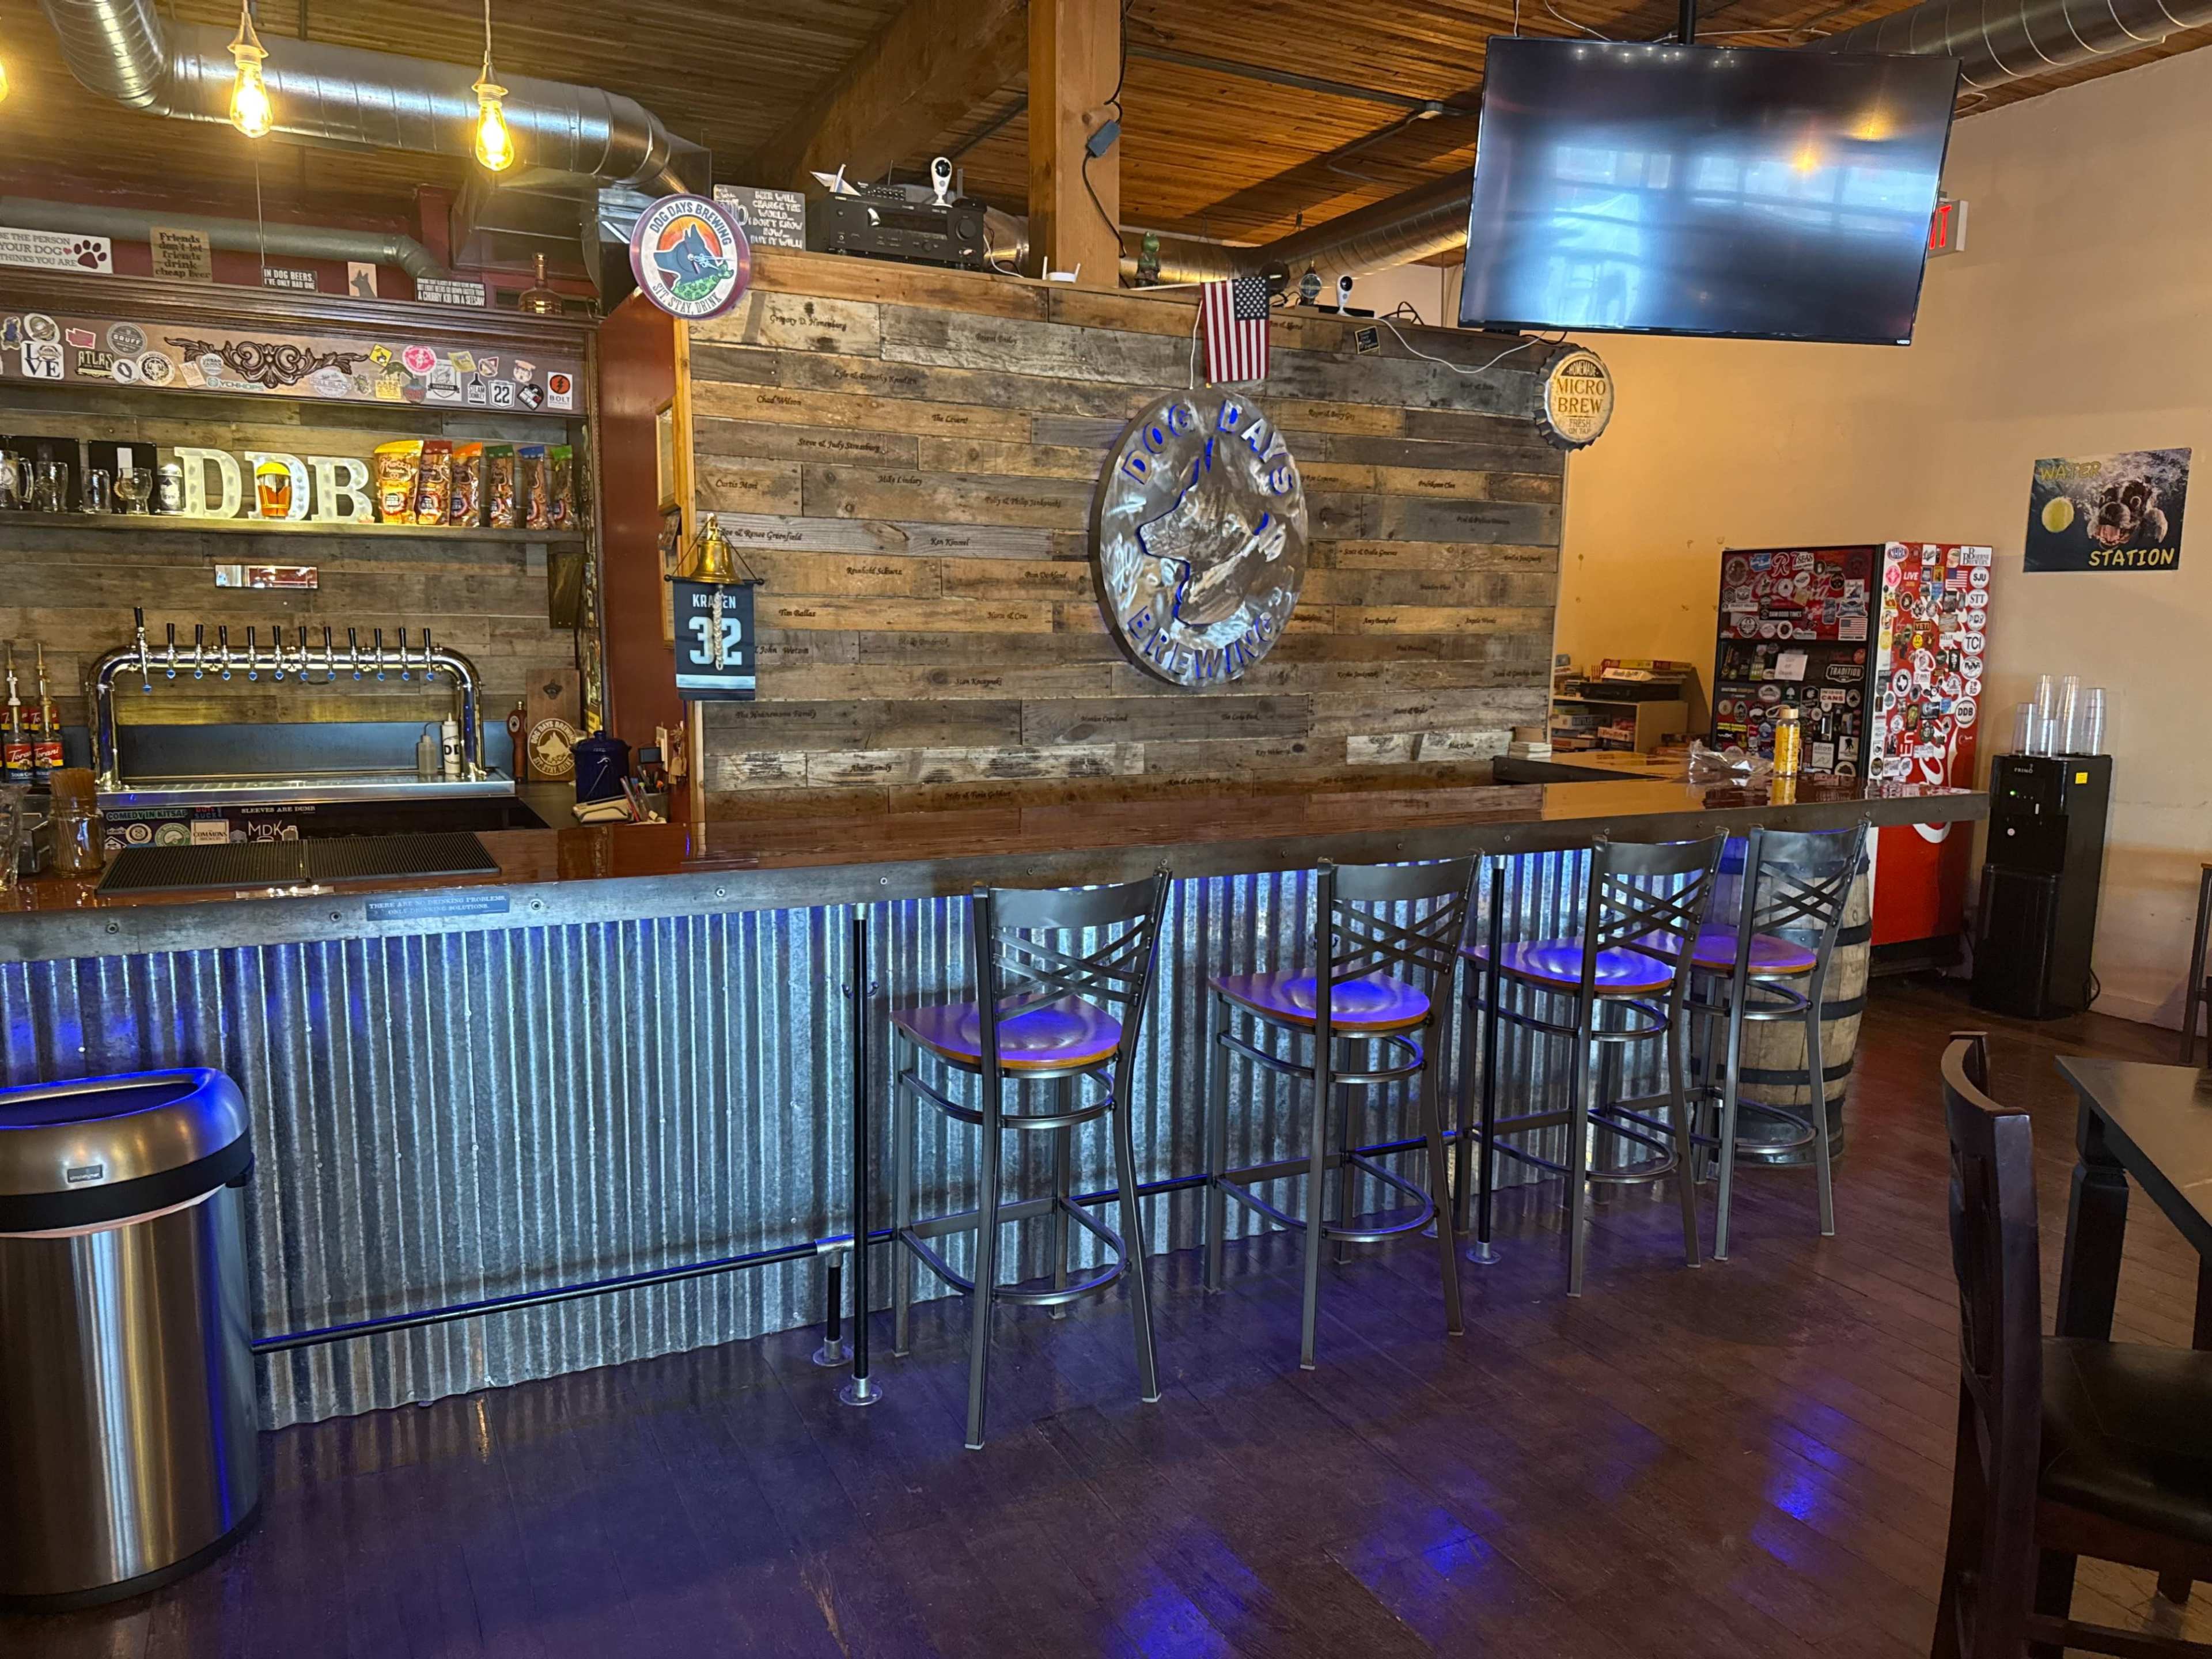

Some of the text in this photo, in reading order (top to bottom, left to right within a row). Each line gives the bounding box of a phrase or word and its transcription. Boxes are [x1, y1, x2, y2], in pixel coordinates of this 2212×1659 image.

[755, 191, 797, 203] BEER WILL
[649, 202, 732, 246] DOG DAYS BREWING
[779, 219, 803, 230] KNOW
[11, 233, 70, 245] THE PERSON
[159, 232, 200, 243] Friends
[750, 234, 767, 244] BUT
[768, 237, 778, 245] IT
[0, 242, 63, 255] YOUR DOG
[159, 241, 203, 252] don't let
[0, 253, 78, 267] THINKS YOU ARE
[162, 250, 201, 260] friends
[164, 259, 197, 270] drink
[156, 267, 211, 279] cheap beer
[264, 268, 271, 277] IN
[273, 270, 288, 279] DOG
[276, 279, 290, 287] ONLY
[291, 280, 304, 288] HAD
[304, 282, 315, 290] ONE
[453, 294, 460, 304] ON
[695, 291, 722, 313] DRINK
[113, 334, 142, 346] GRUFF
[78, 352, 114, 370] ATLAS
[1568, 361, 1597, 377] HOMEMADE
[1556, 378, 1606, 396] MICRO
[494, 385, 510, 404] 22
[756, 394, 802, 406] Chad Wilson
[1557, 396, 1604, 414] BREW
[931, 414, 944, 423] The
[1569, 418, 1592, 428] FRESH
[797, 437, 844, 452] Steve & Judy
[1122, 399, 1294, 495] DOG DAYS
[2039, 461, 2102, 480] WATER
[715, 478, 738, 488] Curtis
[878, 475, 896, 485] Mike
[766, 531, 802, 541] Greenfield
[930, 537, 944, 546] Ken
[2088, 547, 2175, 567] STATION
[1903, 571, 1919, 581] LIVE
[1973, 573, 1987, 582] SJU
[692, 593, 737, 609] KRAEN
[1970, 594, 1985, 604] STT
[778, 609, 816, 618] Tim Ballas
[1014, 612, 1029, 620] Cow
[1915, 623, 1930, 631] YETI
[688, 616, 743, 666] 32
[1126, 605, 1277, 680] BREWING
[1965, 636, 1982, 650] TCI
[759, 645, 778, 655] John
[1830, 667, 1861, 677] TRADITION
[1957, 707, 1974, 717] DDB
[531, 730, 541, 744] DOG
[537, 721, 554, 732] DAYS
[107, 811, 144, 820] COMEDY
[248, 820, 283, 836] MDK
[427, 897, 465, 906] DRINKING
[410, 906, 447, 914] DRINKING
